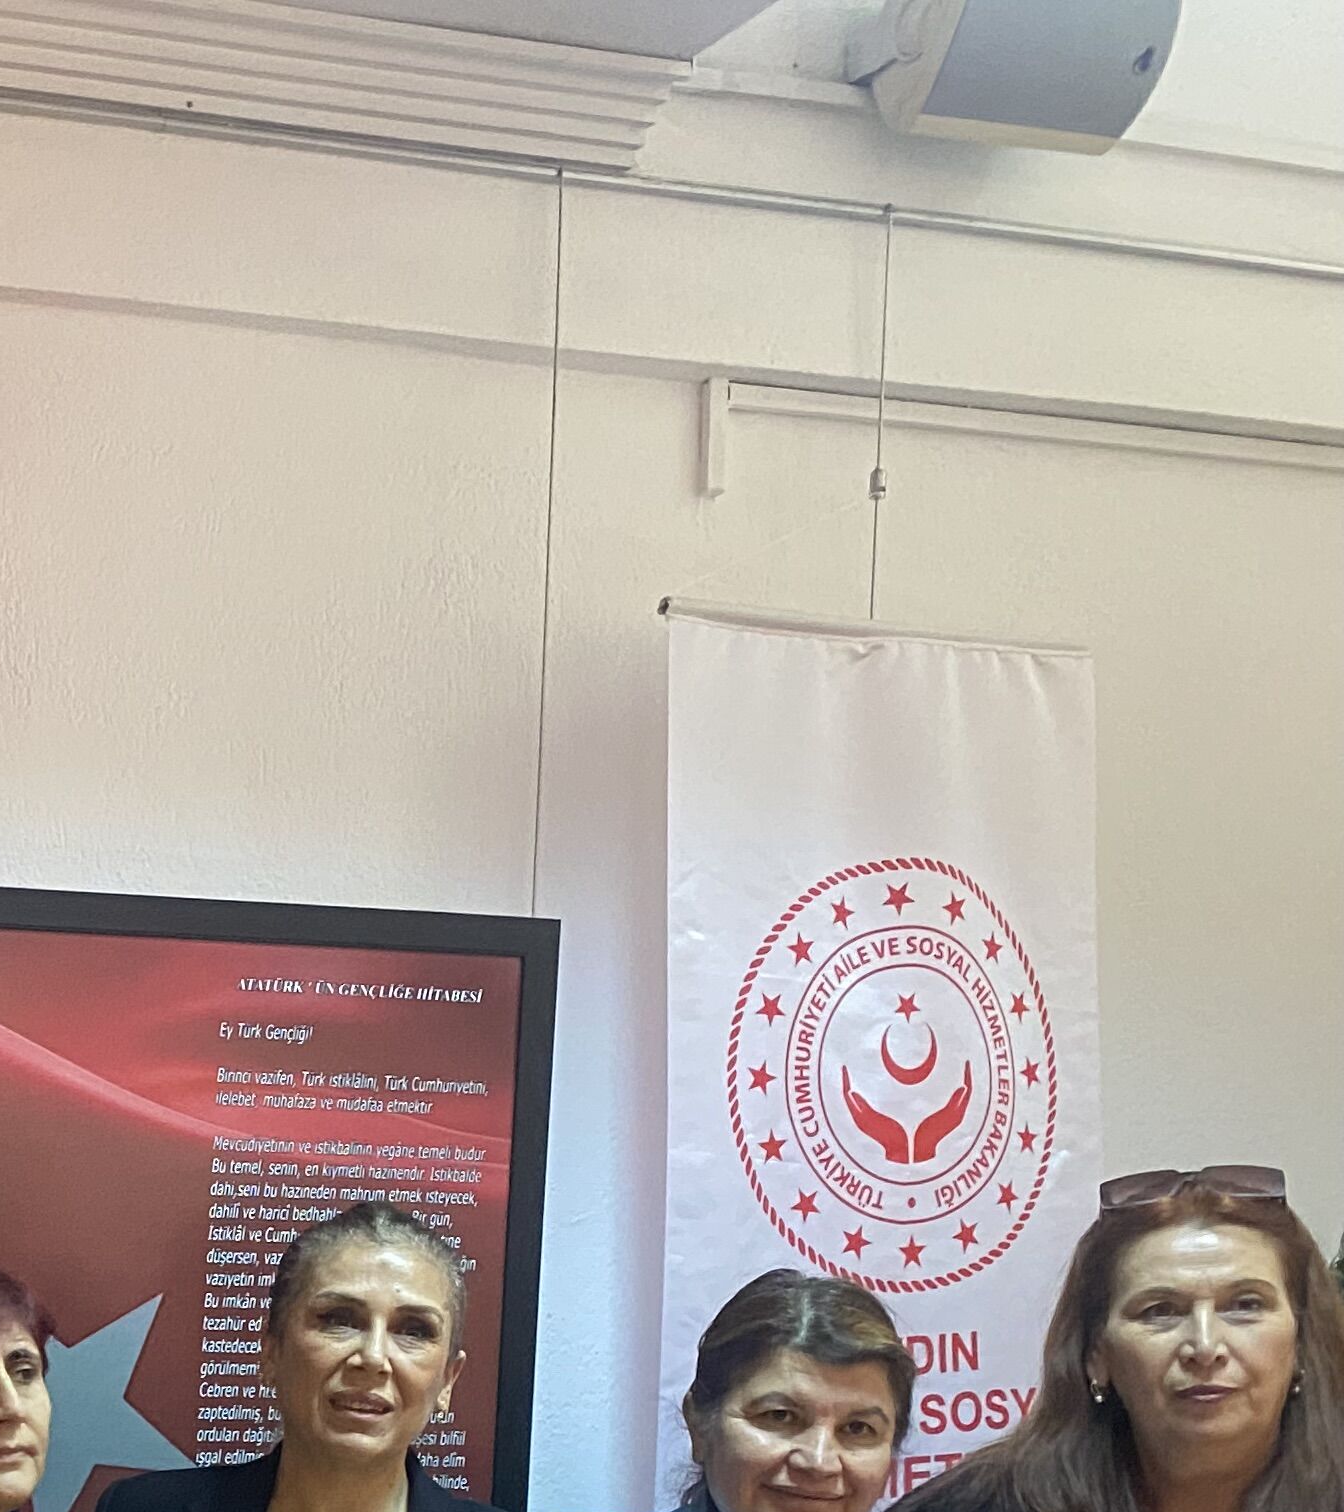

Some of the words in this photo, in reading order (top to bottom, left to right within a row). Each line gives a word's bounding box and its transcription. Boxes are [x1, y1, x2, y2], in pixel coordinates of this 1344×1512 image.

[871, 936, 901, 960] VE
[834, 945, 872, 984] AİLE
[906, 935, 972, 983] SOSYAL
[338, 983, 414, 999] GENÇLİĞE
[416, 985, 484, 1003] HİTABESİ
[219, 1021, 233, 1040] Ey
[237, 1022, 263, 1039] Türk
[971, 976, 1011, 1106] HİZMETLER
[794, 973, 836, 1138] CUMHURİYETİ
[302, 1070, 326, 1087] Türk
[384, 1074, 409, 1091] Türk
[262, 1092, 316, 1110] muhafaza
[320, 1098, 333, 1111] ve
[336, 1095, 383, 1113] müdafaa
[299, 1142, 312, 1154] ve
[376, 1141, 417, 1160] yegâne
[934, 1110, 1008, 1210] BAKANLIĞI
[211, 1157, 226, 1174] Bu
[304, 1164, 319, 1177] en
[811, 1138, 885, 1211] TÜRKİYE
[263, 1182, 279, 1198] bu
[280, 1183, 337, 1200] hazineden
[339, 1185, 386, 1202] mahrum
[388, 1188, 422, 1203] etmek
[242, 1206, 257, 1220] ve
[248, 1229, 263, 1242] ve
[205, 1272, 255, 1290] vaziyetin
[204, 1292, 219, 1309] Bu
[222, 1293, 257, 1309] imkân
[259, 1297, 273, 1310] ve
[202, 1315, 247, 1331] tezahür
[902, 1330, 980, 1376] DIN
[198, 1381, 240, 1399] Cebren
[242, 1386, 257, 1399] ve
[919, 1386, 1038, 1435] SOSY
[196, 1426, 240, 1443] orduları
